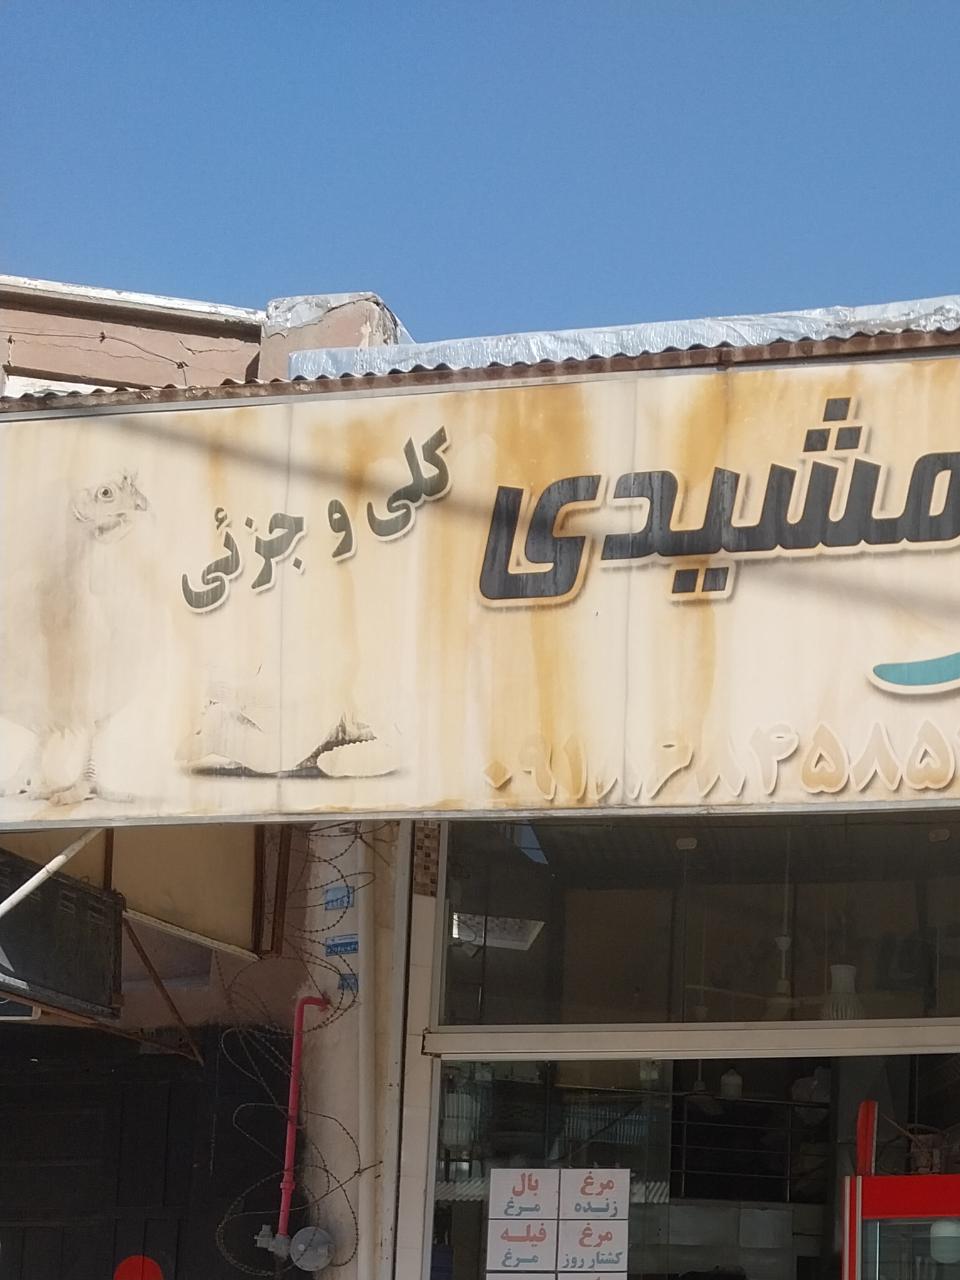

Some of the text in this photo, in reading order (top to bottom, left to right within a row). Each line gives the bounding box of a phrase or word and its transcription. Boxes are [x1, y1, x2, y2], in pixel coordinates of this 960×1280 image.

[181, 426, 449, 610] کلی و جزئی
[512, 1173, 539, 1197] بال
[581, 1171, 615, 1196] مرغ
[504, 1197, 541, 1216] مرغ
[575, 1198, 618, 1217] زنده
[501, 1222, 547, 1247] فیله
[579, 1222, 613, 1248] مرغ
[502, 1249, 539, 1267] مرغ
[563, 1251, 622, 1268] کشتار روز
